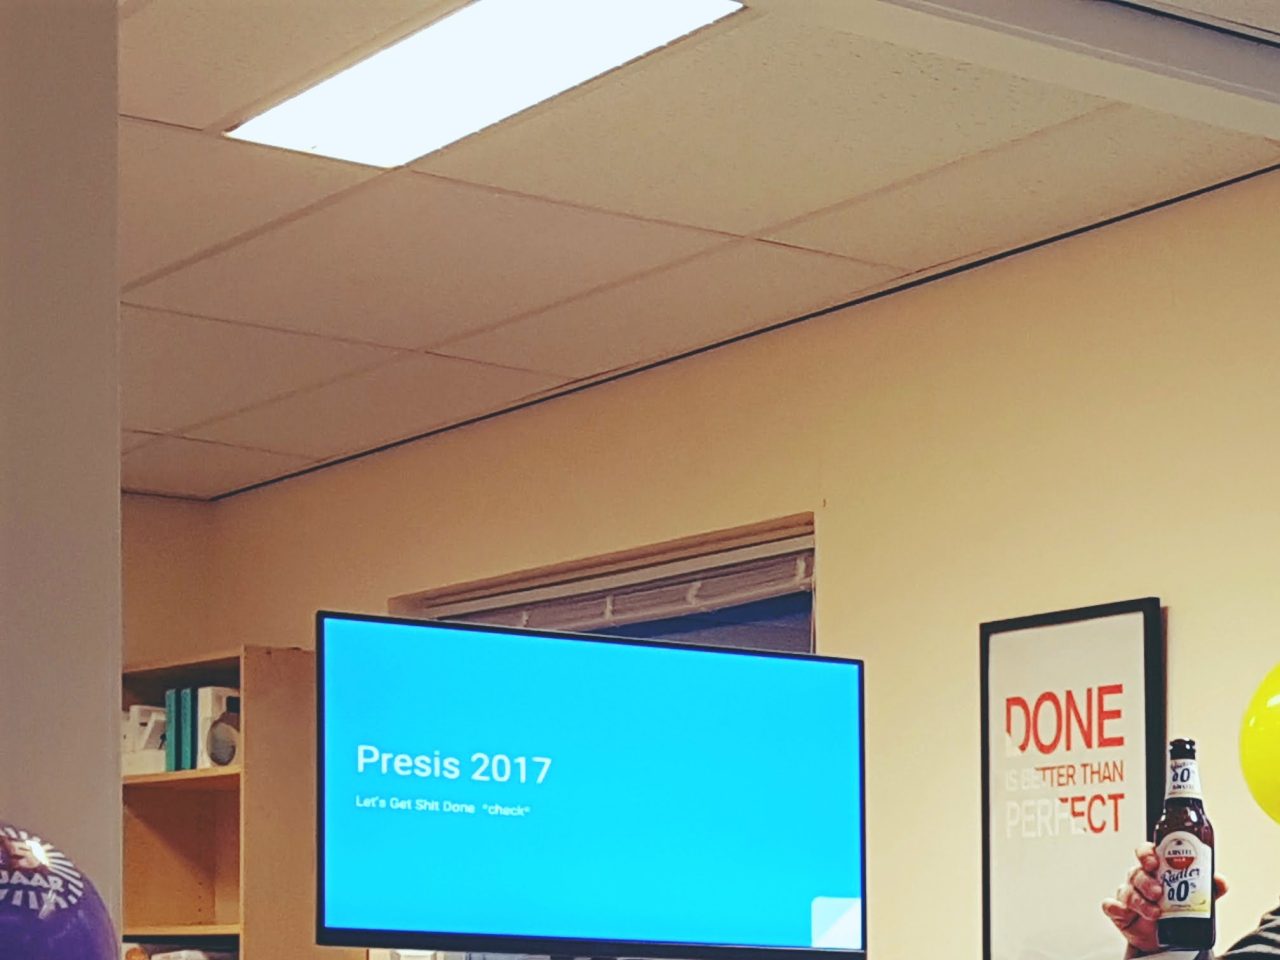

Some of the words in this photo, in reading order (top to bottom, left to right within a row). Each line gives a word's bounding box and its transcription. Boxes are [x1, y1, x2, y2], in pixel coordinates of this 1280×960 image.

[1005, 684, 1125, 756] DONE
[357, 744, 461, 780] Presis
[470, 752, 552, 784] 2017
[1080, 760, 1125, 785] THAN
[355, 795, 387, 810] Let's
[389, 797, 412, 811] Get
[415, 799, 440, 813] Shit
[442, 800, 476, 815] Done
